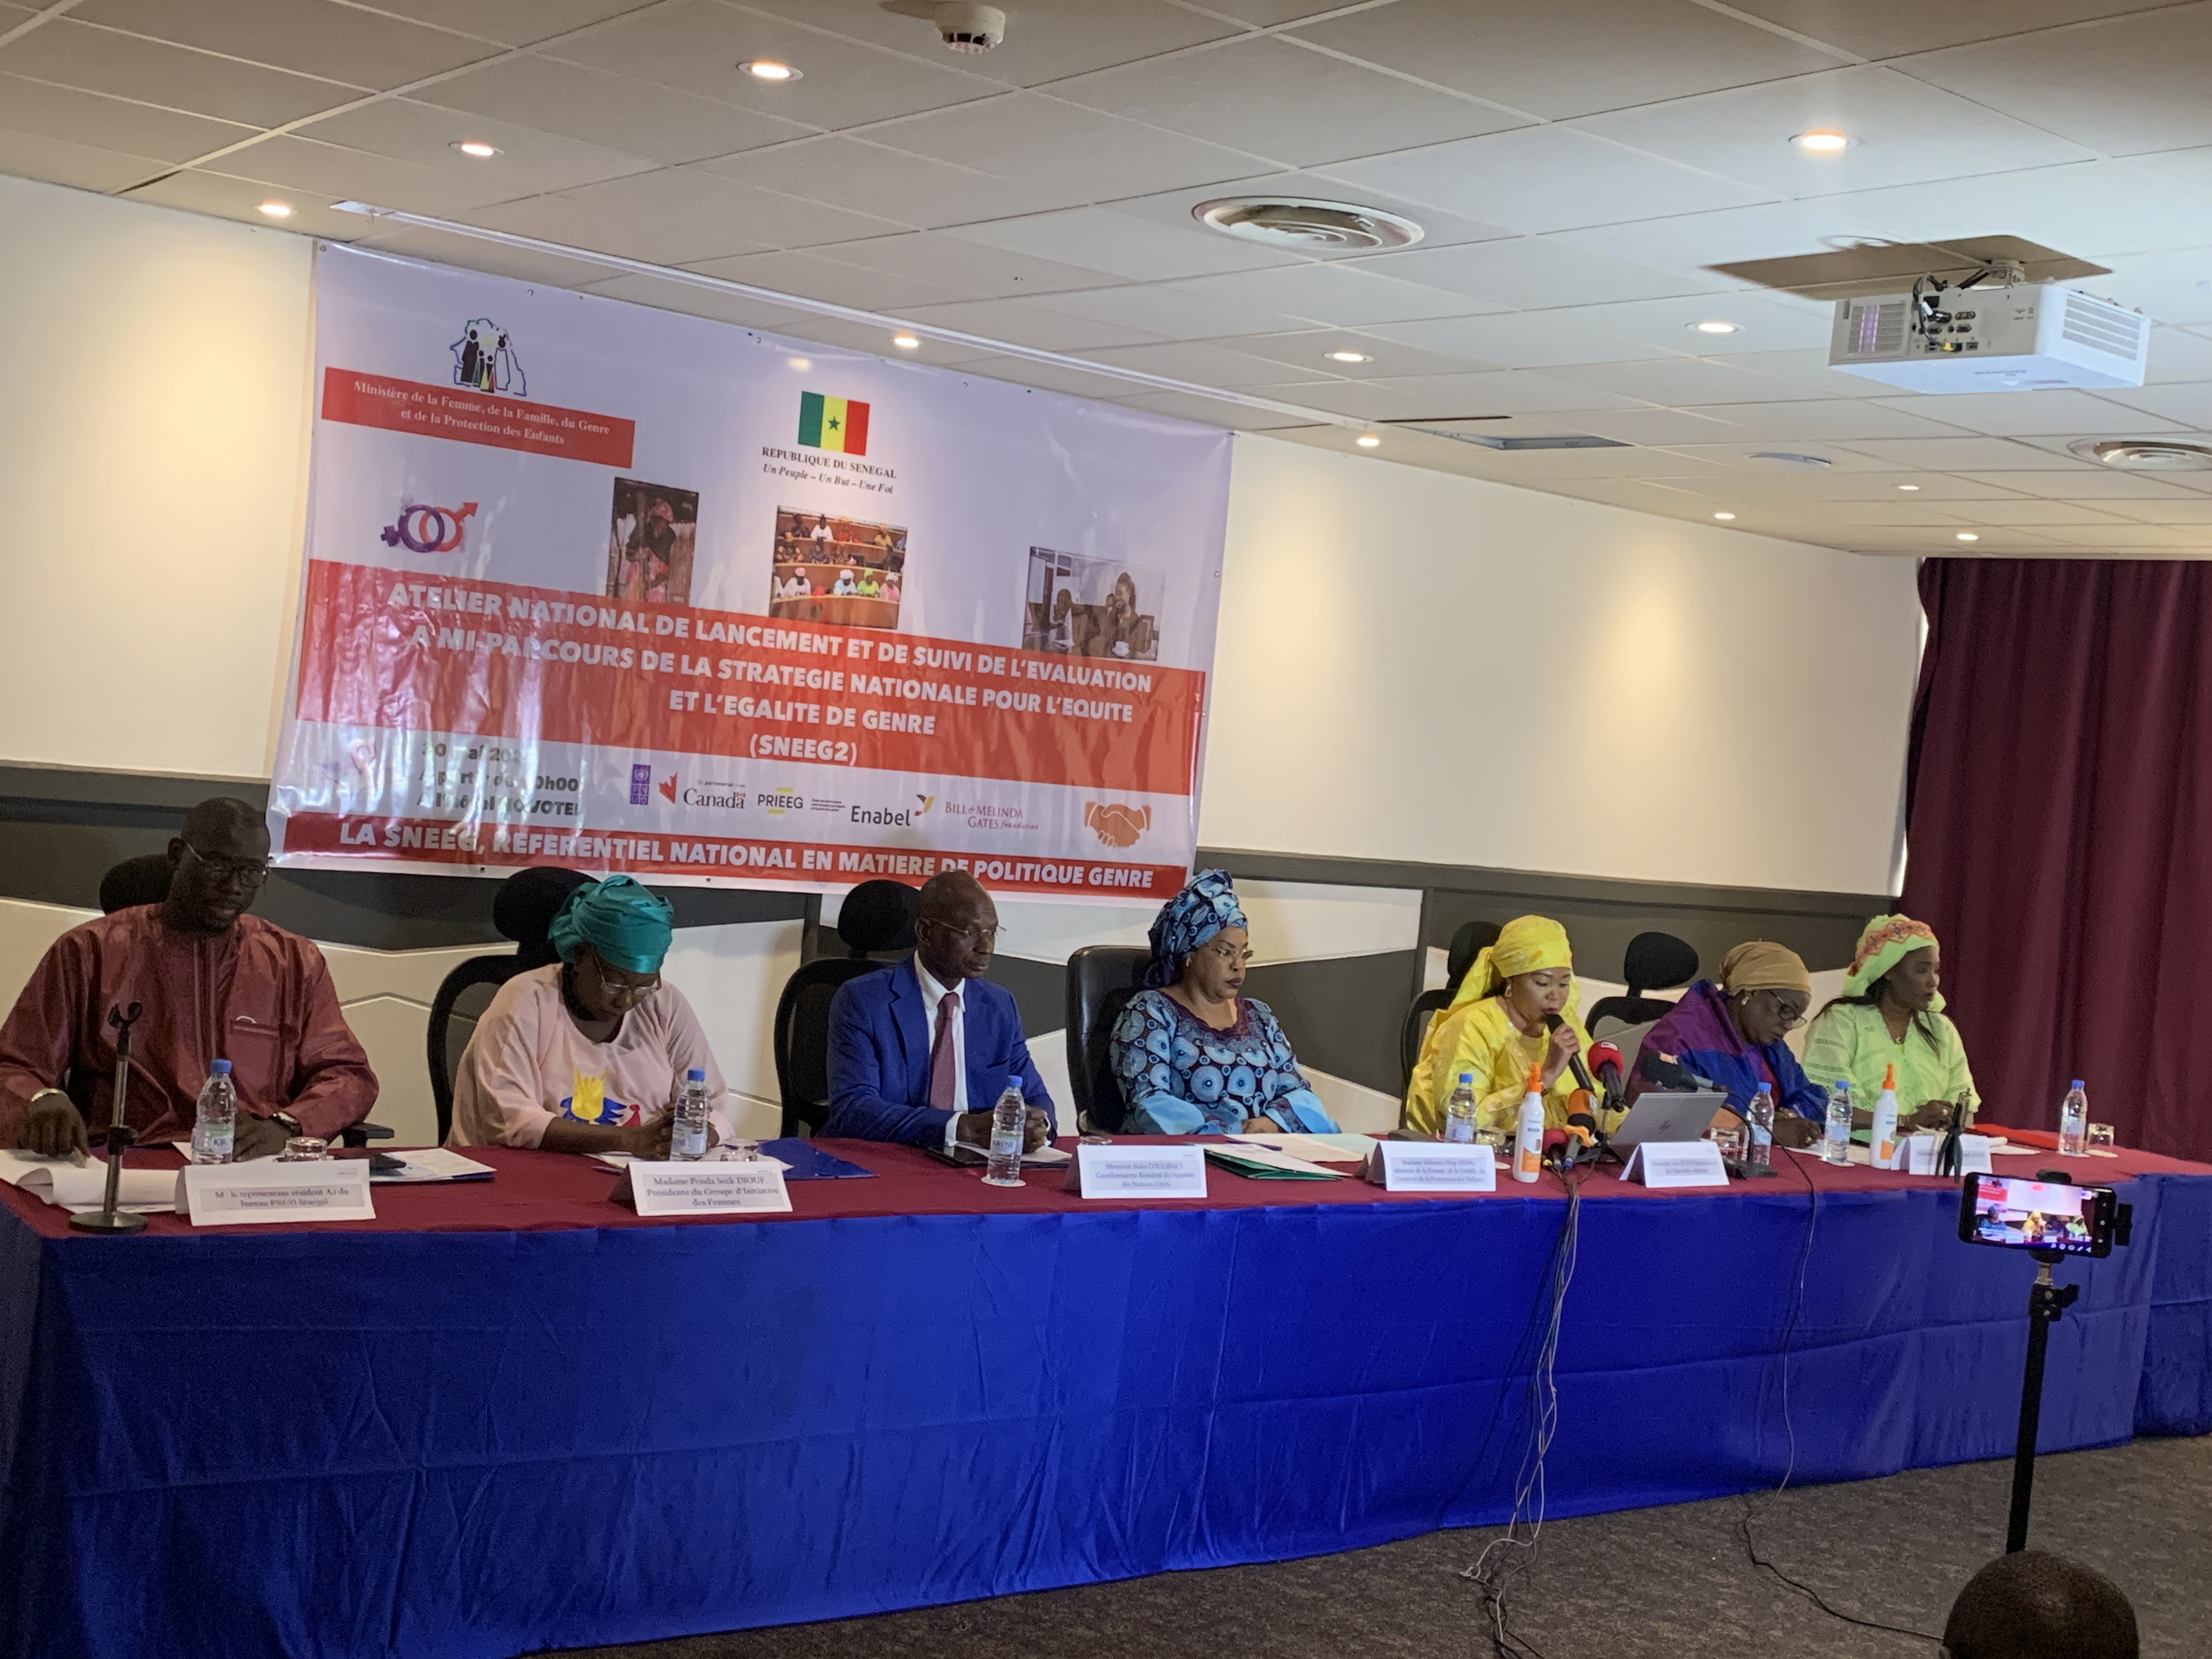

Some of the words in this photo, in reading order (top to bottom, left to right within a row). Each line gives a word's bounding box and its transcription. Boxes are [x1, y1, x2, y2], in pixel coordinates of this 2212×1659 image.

[354, 381, 408, 400] Ministère
[411, 392, 425, 403] de
[427, 394, 438, 405] la
[441, 396, 485, 414] Femme,
[487, 404, 500, 415] de
[504, 407, 513, 418] la
[516, 408, 559, 427] Famille,
[561, 417, 575, 428] du
[578, 420, 610, 435] Genre
[401, 410, 410, 419] et
[414, 410, 427, 421] de
[430, 412, 441, 424] la
[444, 415, 500, 433] Protection
[503, 426, 521, 437] des
[524, 428, 565, 444] Enfants
[762, 447, 830, 467] REPUBLIQUE
[833, 460, 848, 470] DU
[850, 462, 897, 478] SENEGAL
[763, 464, 776, 473] Un
[779, 466, 808, 480] Peuple
[819, 473, 831, 483] Un
[834, 476, 850, 487] But
[859, 480, 876, 491] Une
[878, 483, 893, 494] Foi
[387, 583, 500, 616] ATELIER
[509, 596, 649, 634] NATIONAL
[656, 614, 690, 638] DE
[695, 619, 843, 657] LANCEMENT
[847, 638, 874, 659] ET
[878, 642, 908, 664] DE
[912, 646, 972, 672] SUIVI
[978, 654, 1006, 675] DE
[1011, 659, 1152, 693] L'EVALUATION
[409, 624, 432, 648] A
[640, 650, 675, 673] DE
[681, 654, 712, 678] LA
[718, 659, 844, 691] STRATEGIE
[850, 673, 977, 706] NATIONALE
[983, 689, 1041, 713] POUR
[1046, 696, 1133, 723] L'EQUITE
[669, 690, 699, 712] ET
[704, 695, 821, 724] L'EGALITE
[826, 706, 856, 727] DE
[862, 710, 936, 735] GENRE
[422, 742, 447, 757] 0
[489, 747, 530, 764] 202
[749, 733, 857, 766] (SNEEG2)
[525, 775, 579, 792] 0h00
[684, 788, 746, 809] Canada
[758, 794, 803, 809] PRIEEG
[945, 802, 967, 815] BILL
[976, 805, 1023, 819] MELINDA
[850, 804, 911, 827] Enabel
[968, 816, 998, 829] GATES
[1000, 820, 1039, 830] foundation
[340, 822, 376, 845] LA
[493, 832, 663, 861] REFERENTIEL
[670, 842, 796, 868] NATIONAL
[803, 849, 832, 870] EN
[839, 853, 934, 875] MATIERE
[974, 860, 1084, 884] POLITIQUE
[1088, 867, 1153, 888] GENRE
[653, 1177, 689, 1186] Madame
[690, 1177, 715, 1186] Penda
[692, 1188, 703, 1196] du
[704, 1188, 733, 1197] Groupe
